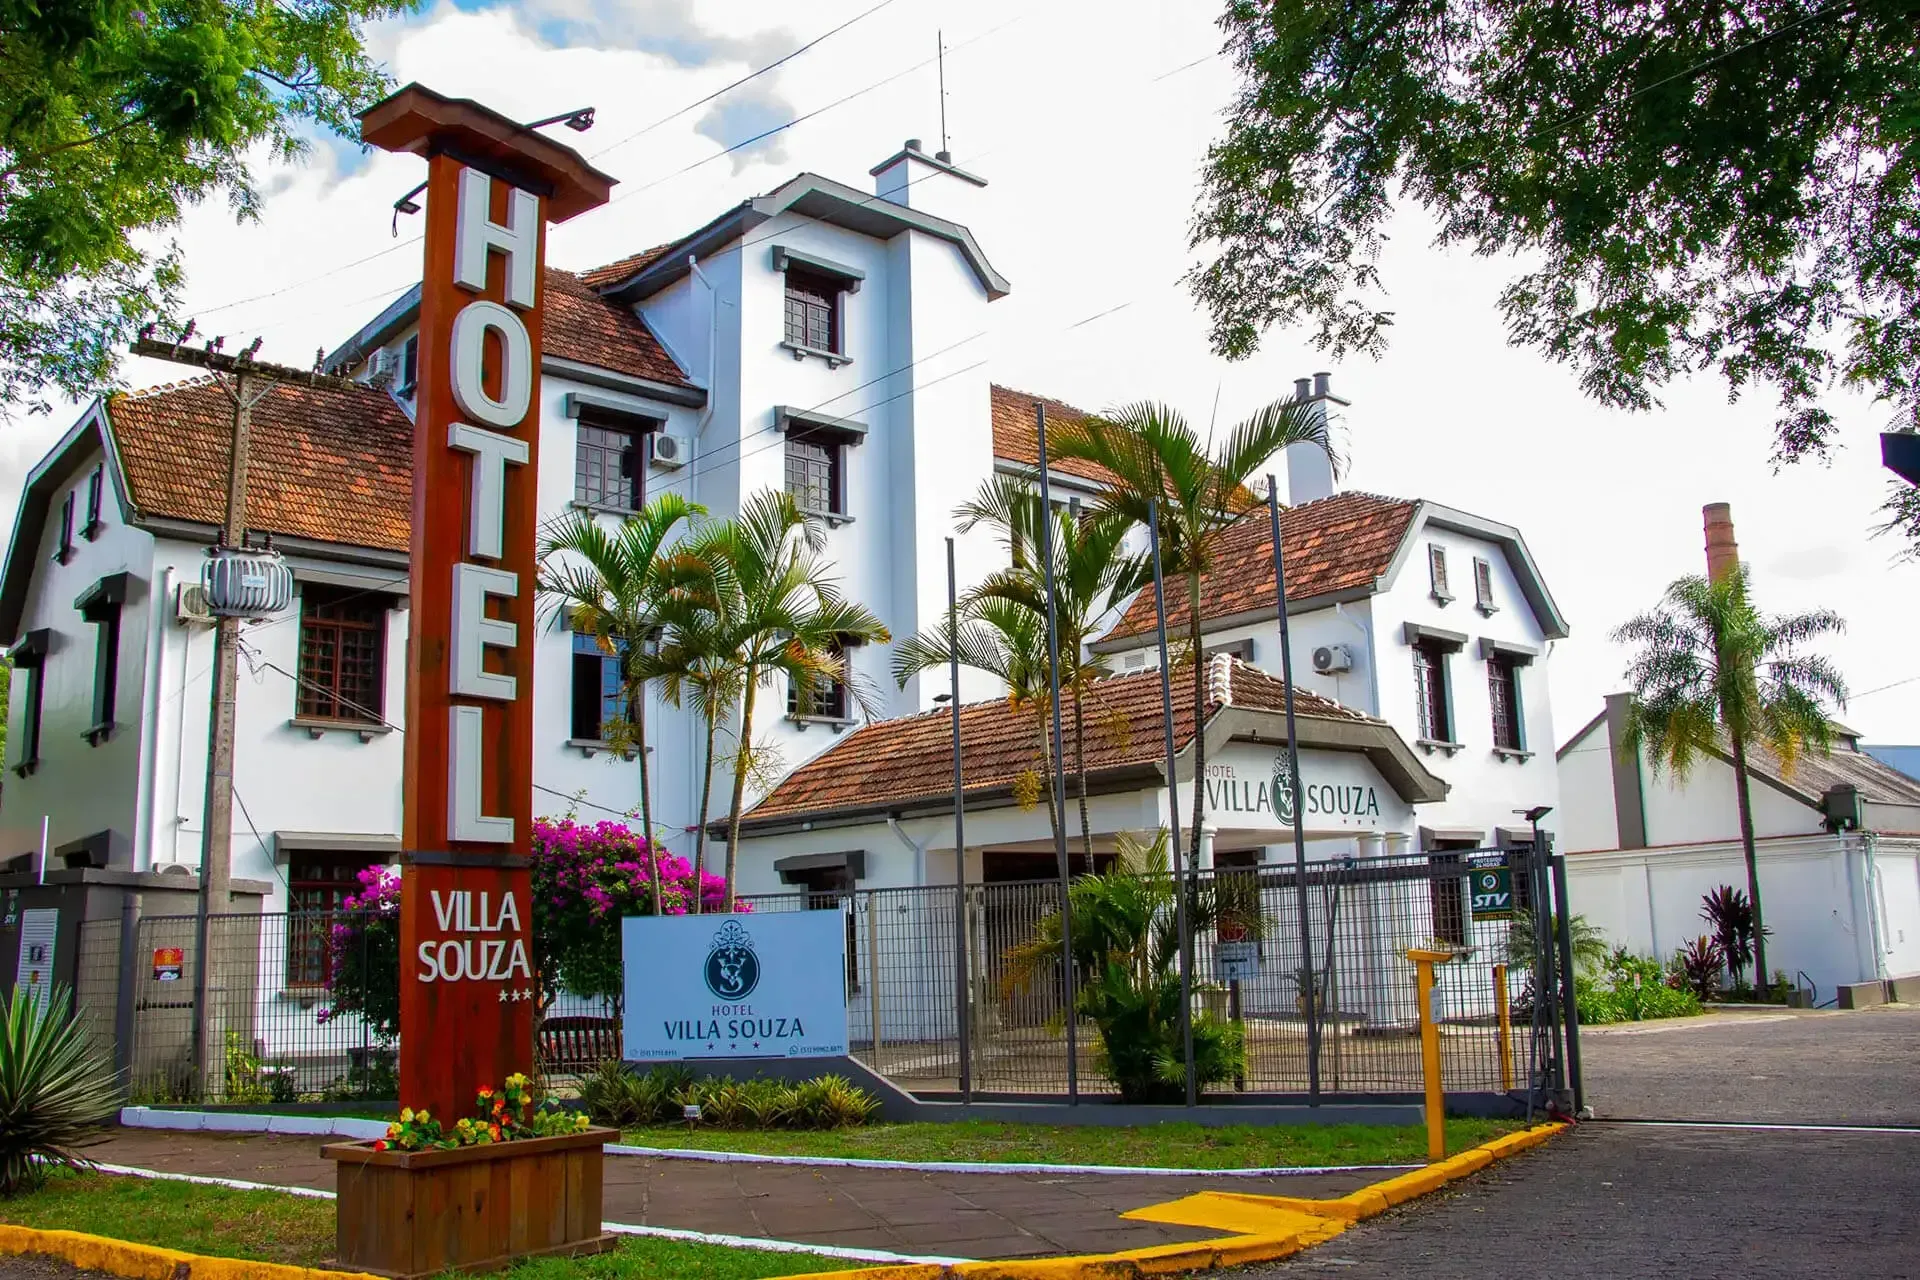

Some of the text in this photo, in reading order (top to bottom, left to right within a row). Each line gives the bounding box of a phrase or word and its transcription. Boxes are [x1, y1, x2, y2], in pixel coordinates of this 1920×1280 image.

[447, 166, 539, 843] HOTEL
[1205, 764, 1236, 778] HOTEL
[1206, 779, 1379, 816] VILLA SOUZA
[430, 890, 521, 932] VILLA
[1472, 893, 1509, 907] STV
[418, 939, 531, 982] SOUZA
[712, 1004, 754, 1016] HOTEL
[664, 1018, 805, 1040] VILLA SOUZA
